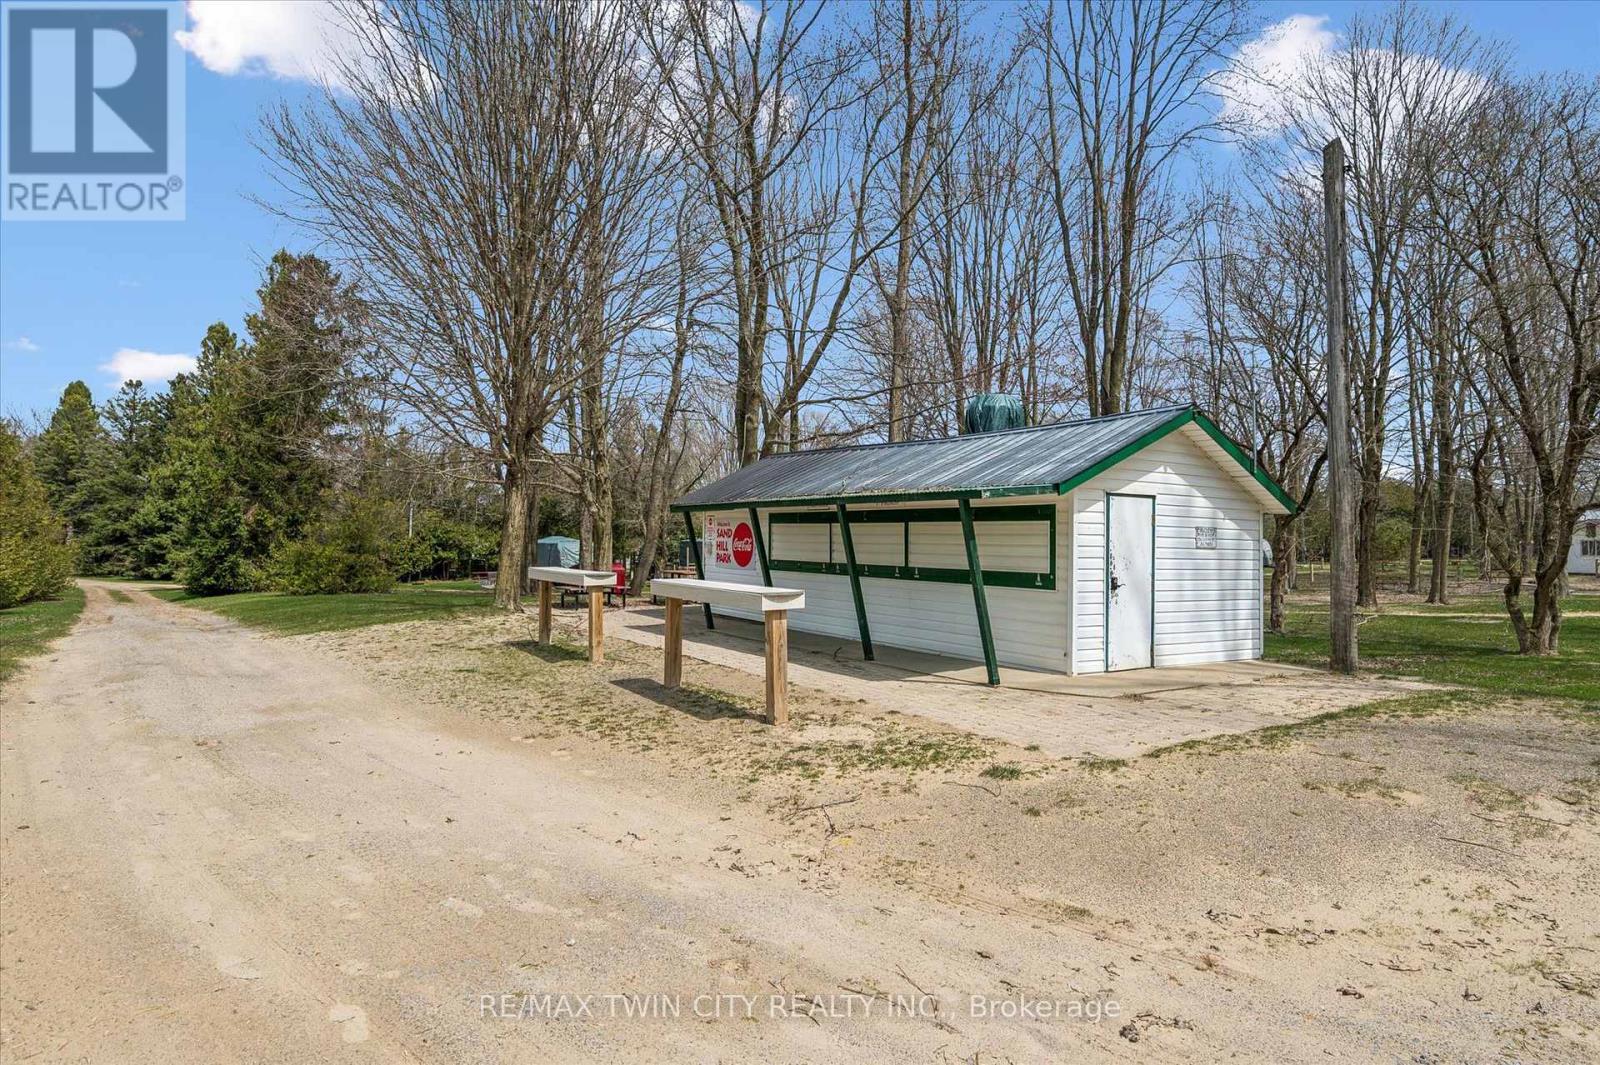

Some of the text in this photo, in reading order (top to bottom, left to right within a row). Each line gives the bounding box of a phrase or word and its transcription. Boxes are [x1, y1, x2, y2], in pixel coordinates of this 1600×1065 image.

[717, 528, 733, 538] SAND
[716, 540, 728, 551] HILL
[716, 552, 731, 563] PARK
